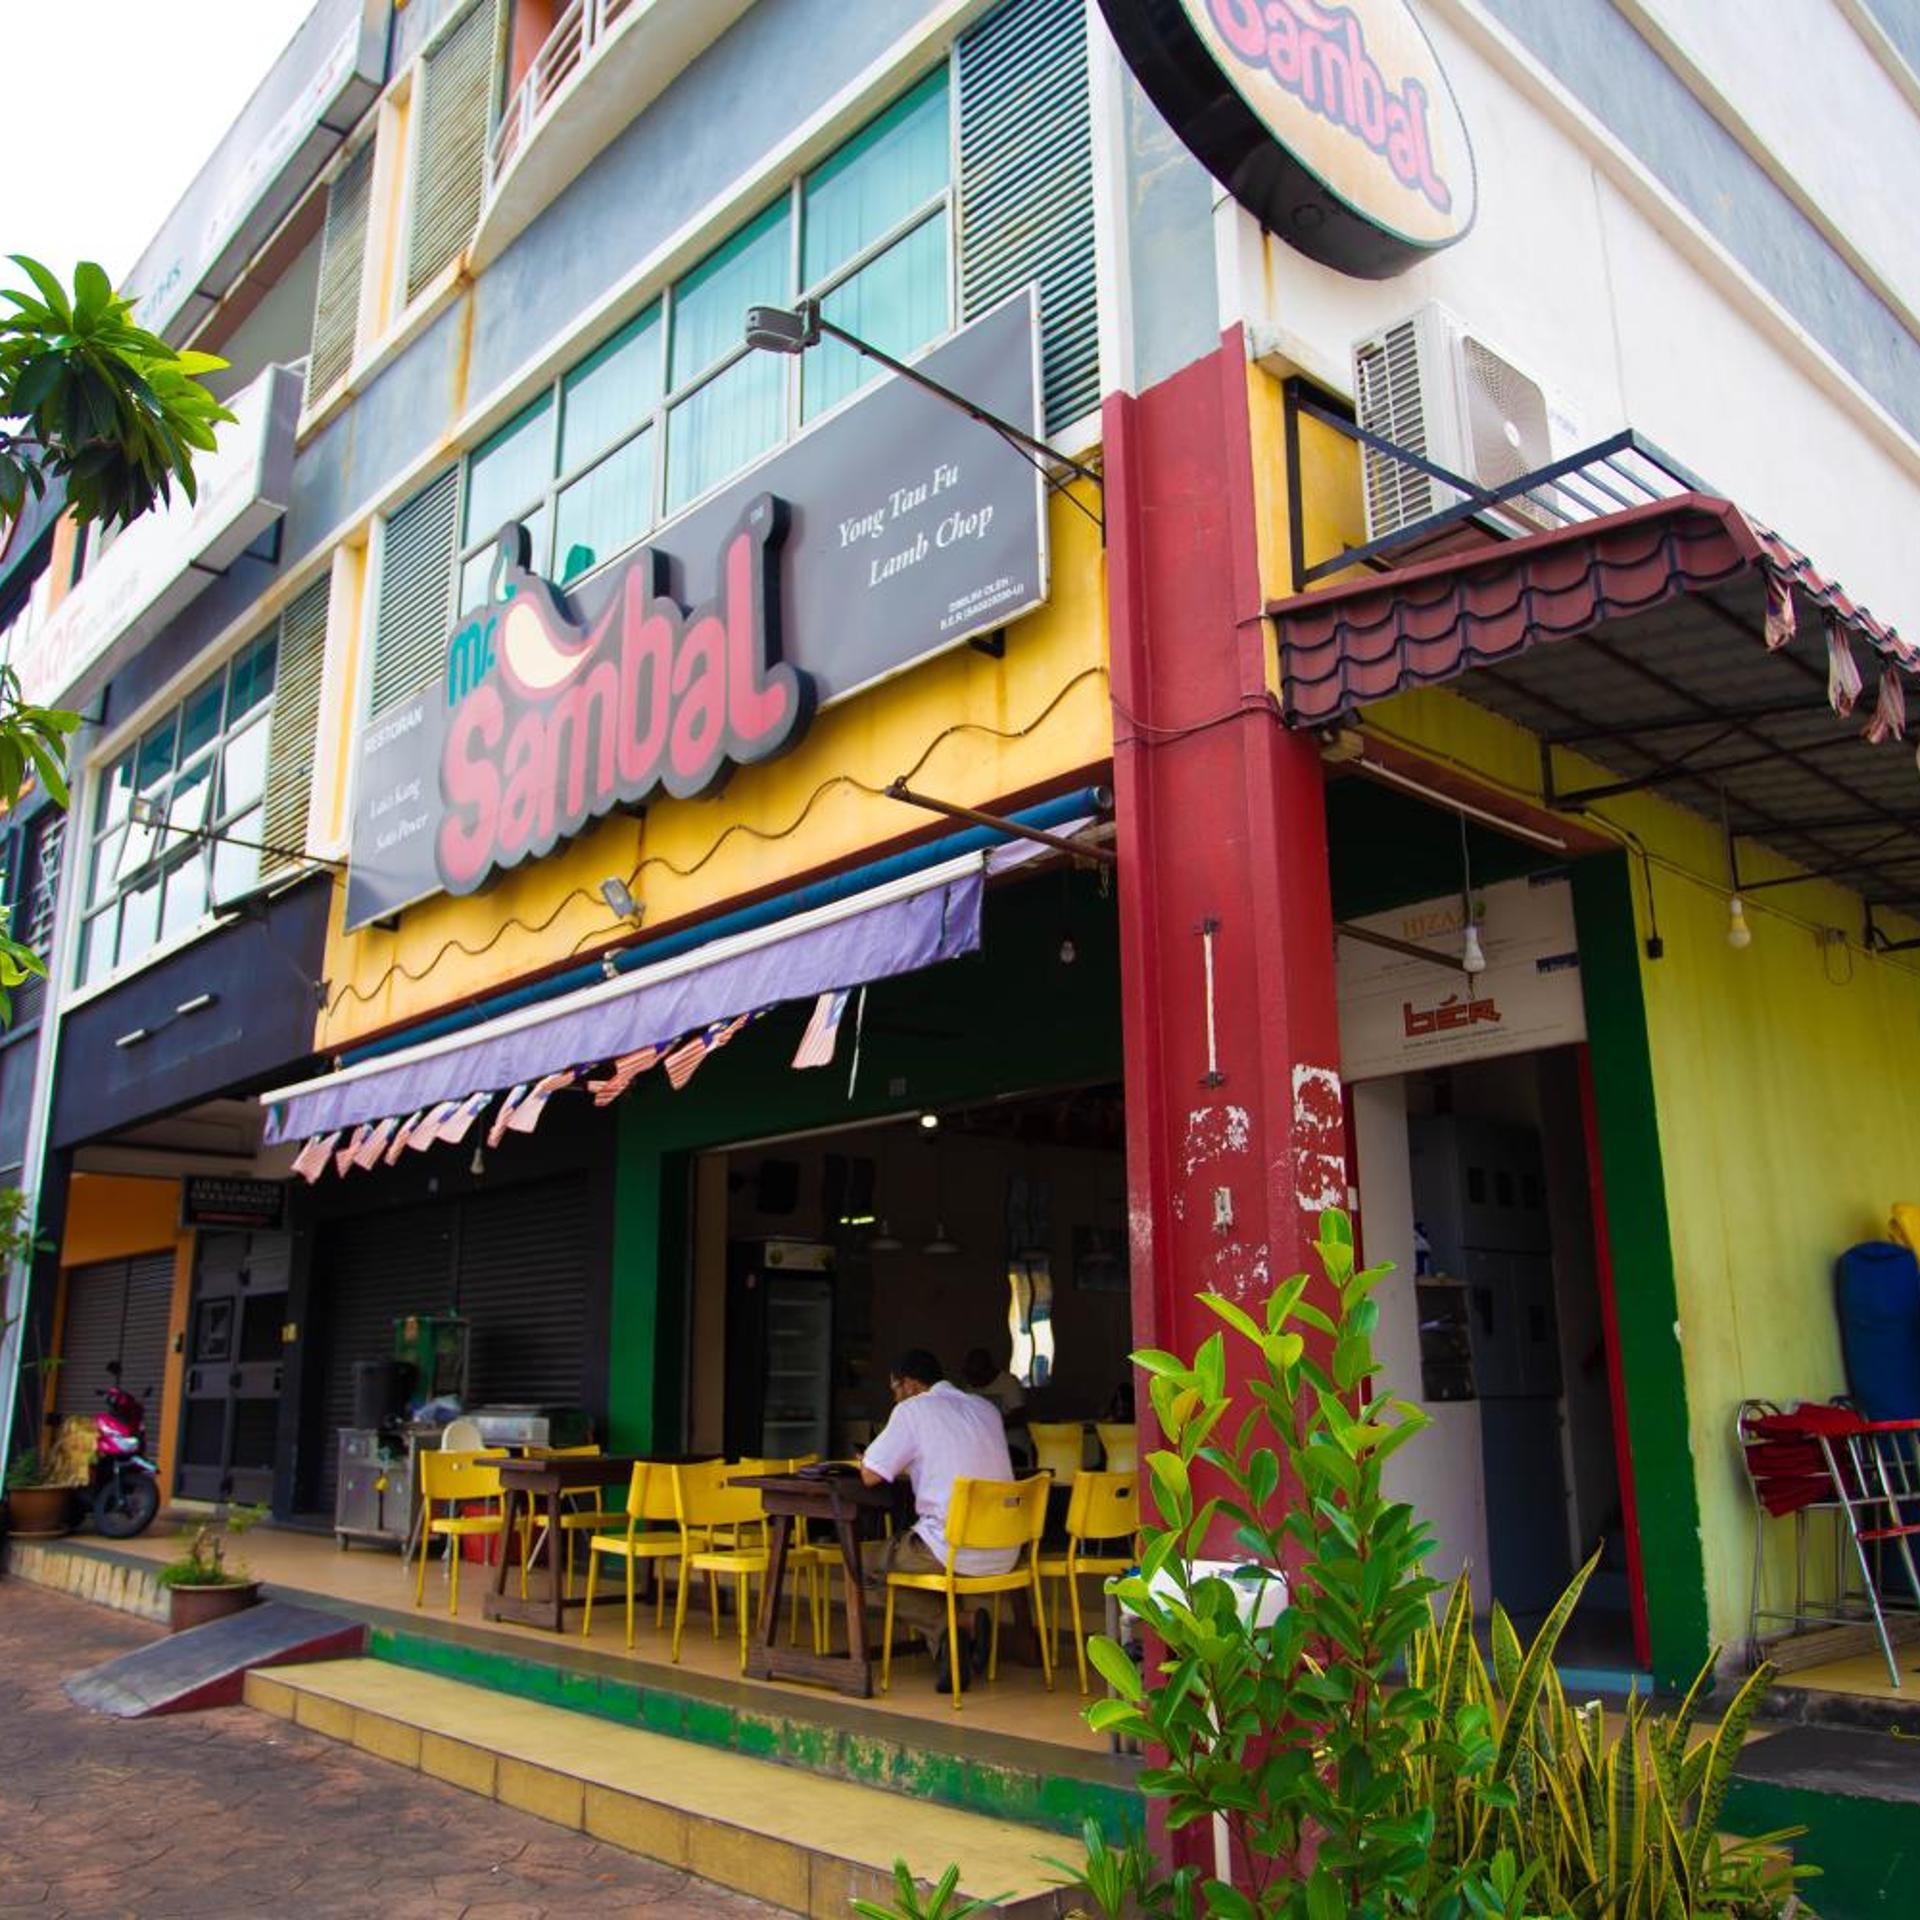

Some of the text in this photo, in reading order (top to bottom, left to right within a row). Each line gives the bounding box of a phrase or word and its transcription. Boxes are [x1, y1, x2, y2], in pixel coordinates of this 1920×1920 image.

[837, 463, 959, 548] Yong Tau Fu
[867, 504, 994, 588] Lamb Chop
[440, 532, 787, 883] Sambal
